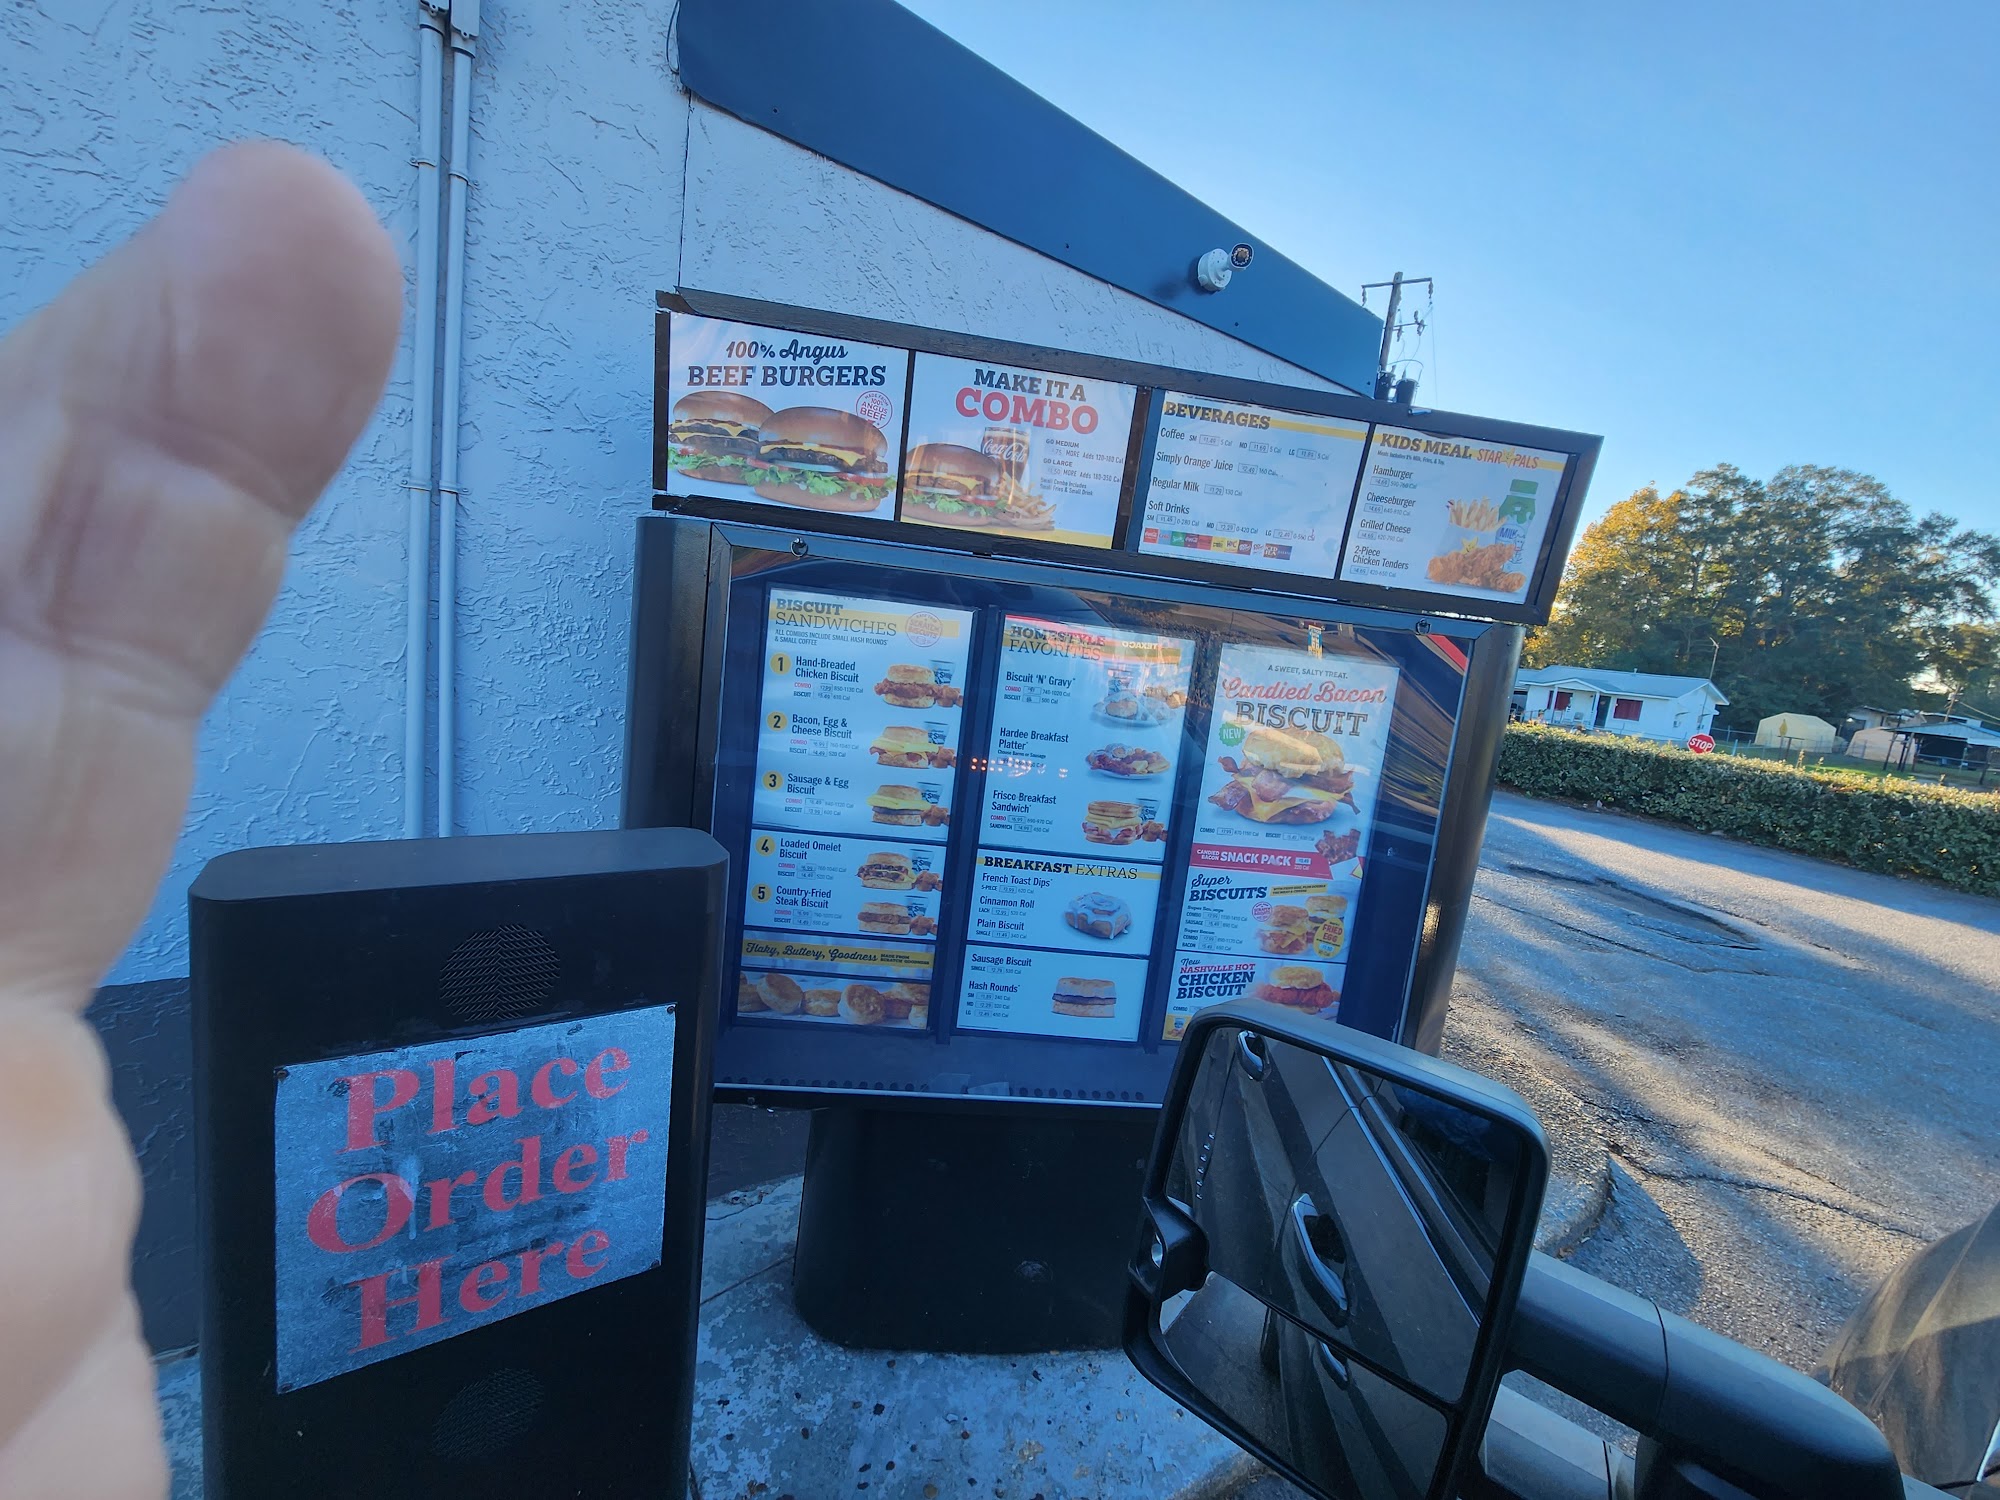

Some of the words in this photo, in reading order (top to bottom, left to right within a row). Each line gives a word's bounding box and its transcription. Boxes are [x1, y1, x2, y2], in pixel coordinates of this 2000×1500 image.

[726, 341, 775, 359] 100%
[779, 339, 848, 365] Angus
[687, 365, 756, 387] BEEF
[761, 365, 886, 387] BURGERS
[974, 368, 1042, 395] MAKE
[1045, 380, 1069, 399] IT
[1070, 384, 1087, 401] A
[860, 408, 886, 421] BEEF
[861, 402, 888, 414] ANGUS
[955, 387, 1099, 435] COMBO
[1164, 401, 1271, 430] BEVERAGES
[1160, 427, 1185, 440] Coffee
[1056, 440, 1080, 448] MEDIUM
[1083, 452, 1094, 460] Adds
[1380, 434, 1422, 452] KIDS
[1424, 440, 1472, 460] MEAL
[1477, 449, 1502, 463] STAR
[1513, 454, 1539, 469] PALS
[1053, 459, 1073, 467] LARGE
[1156, 452, 1182, 466] Simply
[1214, 459, 1234, 471] Juice
[1373, 465, 1413, 480] Hamburger
[1152, 477, 1181, 491] Regular
[1183, 480, 1200, 492] Milk
[1367, 492, 1416, 507] Cheeseburger
[1148, 500, 1164, 511] Soft
[1166, 502, 1190, 515] Drinks
[1361, 519, 1384, 530] Grilled
[1386, 522, 1411, 534] Cheese
[1500, 528, 1517, 540] MILK
[1354, 546, 1381, 557] 2-Piece
[1353, 555, 1381, 567] Chicken
[1382, 558, 1409, 570] Tenders
[776, 599, 844, 616] BISCUIT
[776, 612, 897, 636] SANDWICHES
[786, 630, 808, 638] COMBOS
[809, 632, 831, 640] INCLUDE
[832, 634, 849, 642] SMALL
[798, 638, 817, 646] COFFEE
[1011, 626, 1106, 646] HOMESTYLE
[1009, 639, 1100, 661] FAVORITES
[777, 657, 784, 671] 1
[796, 656, 856, 671] Hand-Breaded
[795, 668, 829, 680] Chicken
[830, 670, 859, 683] Biscuit
[1006, 672, 1034, 683] Biscuit
[1275, 666, 1301, 675] SWEET,
[1302, 668, 1324, 677] SALTY
[1326, 670, 1348, 679] TREAT.
[1222, 677, 1313, 701] Candied
[1314, 680, 1387, 704] Bacon
[773, 715, 781, 729] 2
[792, 714, 820, 726] Bacon,
[824, 716, 839, 729] Egg
[1234, 701, 1368, 737] BISCUIT
[792, 725, 822, 737] Cheese
[824, 728, 852, 739] Biscuit
[1000, 727, 1029, 739] Hardee
[1031, 730, 1069, 743] Breakfast
[1223, 728, 1242, 739] NEW
[1690, 738, 1712, 751] STOP
[769, 774, 777, 788] 3
[787, 773, 822, 786] Sausage
[834, 777, 850, 789] Egg
[787, 784, 815, 796] Biscuit
[993, 790, 1017, 801] Frisco
[1019, 792, 1056, 804] Breakfast
[762, 839, 770, 852] 4
[781, 838, 810, 849] Loaded
[813, 841, 841, 852] Omelet
[780, 849, 808, 860] Biscuit
[1220, 852, 1259, 864] SNACK
[1261, 855, 1291, 866] PACK
[984, 856, 1072, 874] BREAKFAST
[1075, 864, 1138, 879] EXTRAS
[982, 873, 1008, 883] French
[1011, 875, 1031, 885] Toast
[1192, 874, 1232, 889] Super
[758, 887, 766, 900] 5
[777, 886, 832, 899] Country-Fried
[1189, 887, 1267, 902] BISCUITS
[776, 897, 799, 907] Steak
[802, 898, 829, 909] Biscuit
[980, 896, 1018, 907] Cinnamon
[1020, 899, 1035, 908] Roll
[977, 919, 996, 929] Plain
[999, 921, 1024, 930] Biscuit
[1323, 924, 1343, 936] FRIED
[1323, 933, 1339, 943] EGG
[746, 942, 779, 957] Flaky,
[782, 945, 825, 960] Buttery,
[829, 949, 878, 962] Goodness
[972, 954, 1004, 965] Sausage
[1006, 957, 1032, 967] Biscuit
[1181, 958, 1201, 967] New
[1180, 965, 1234, 974] NASHVILLE
[969, 981, 988, 990] Hash
[1178, 972, 1255, 986] CHICKEN
[1176, 984, 1246, 999] BISCUIT
[334, 1046, 631, 1155] Place
[307, 1128, 650, 1254] Order
[348, 1229, 611, 1355] Here
